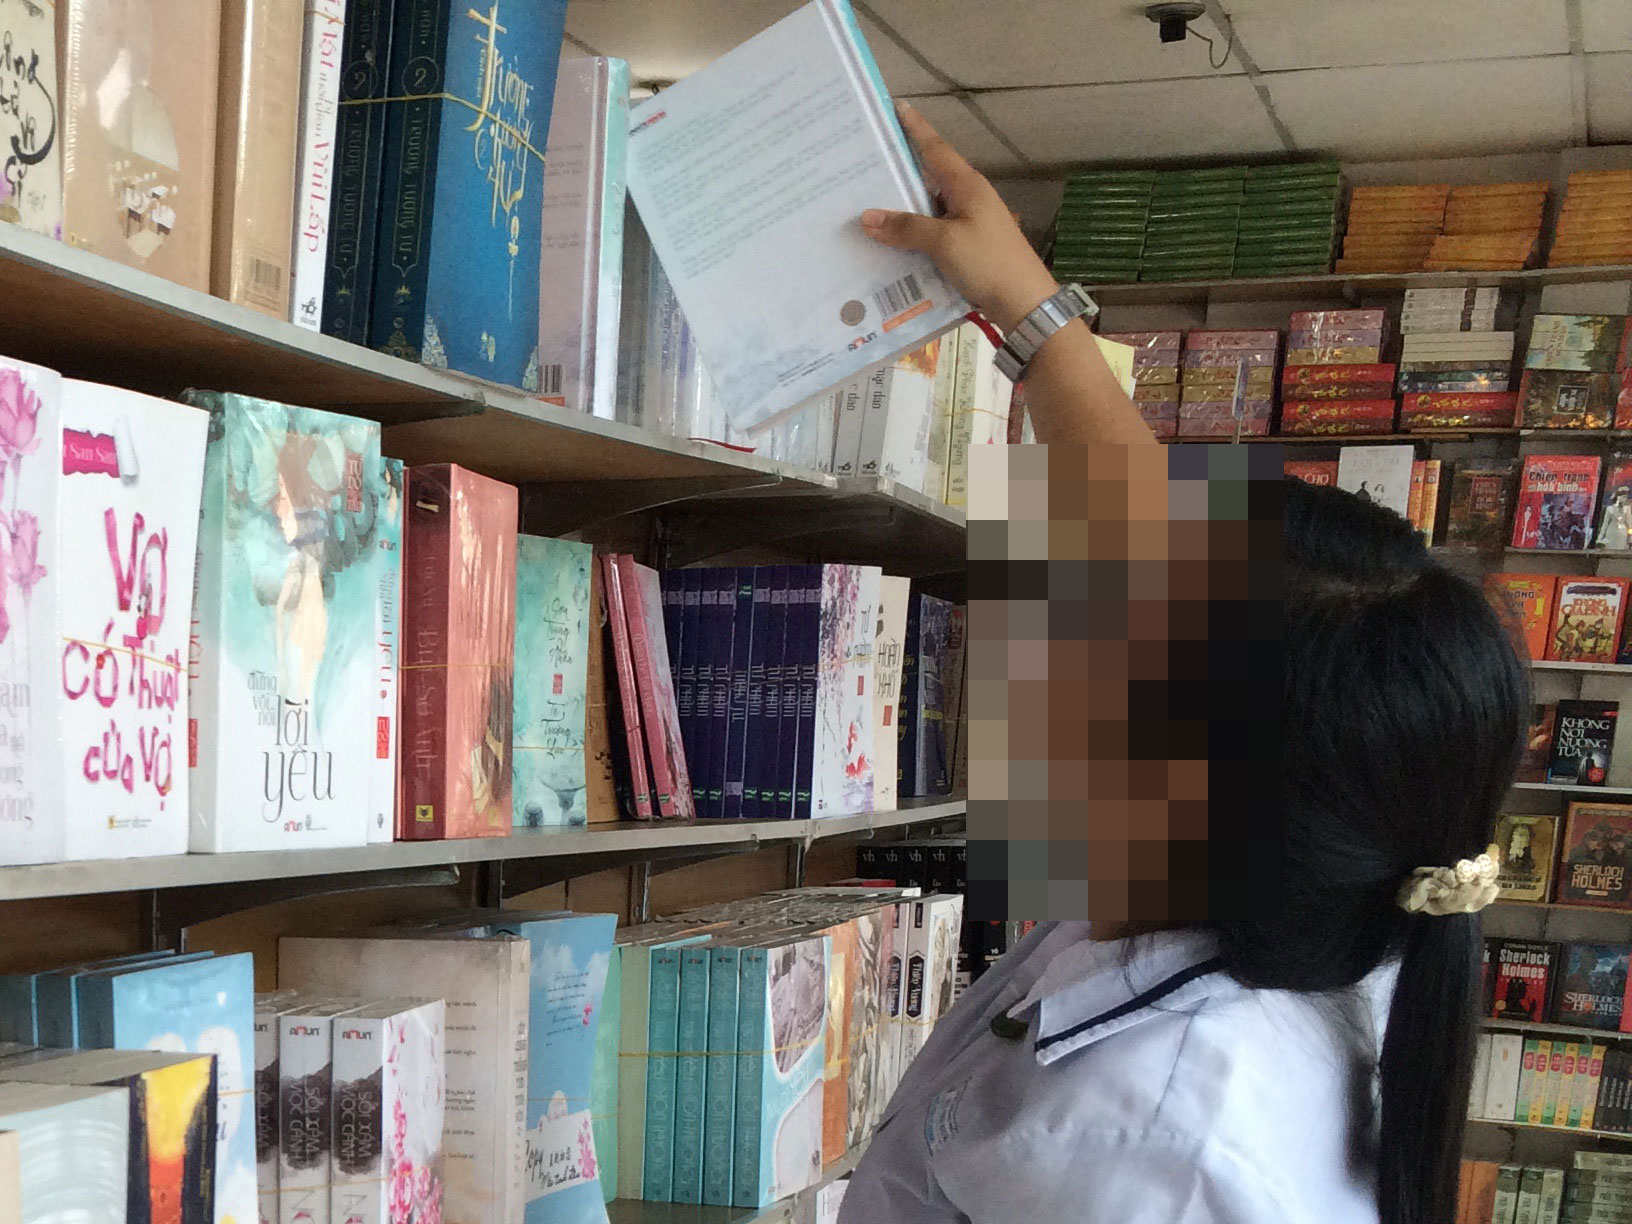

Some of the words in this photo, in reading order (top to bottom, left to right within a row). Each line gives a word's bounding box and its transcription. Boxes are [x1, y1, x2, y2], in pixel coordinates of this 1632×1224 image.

[1571, 877, 1623, 891] HOLMES
[1499, 949, 1551, 966] Sherlock
[1502, 962, 1546, 978] Holmes
